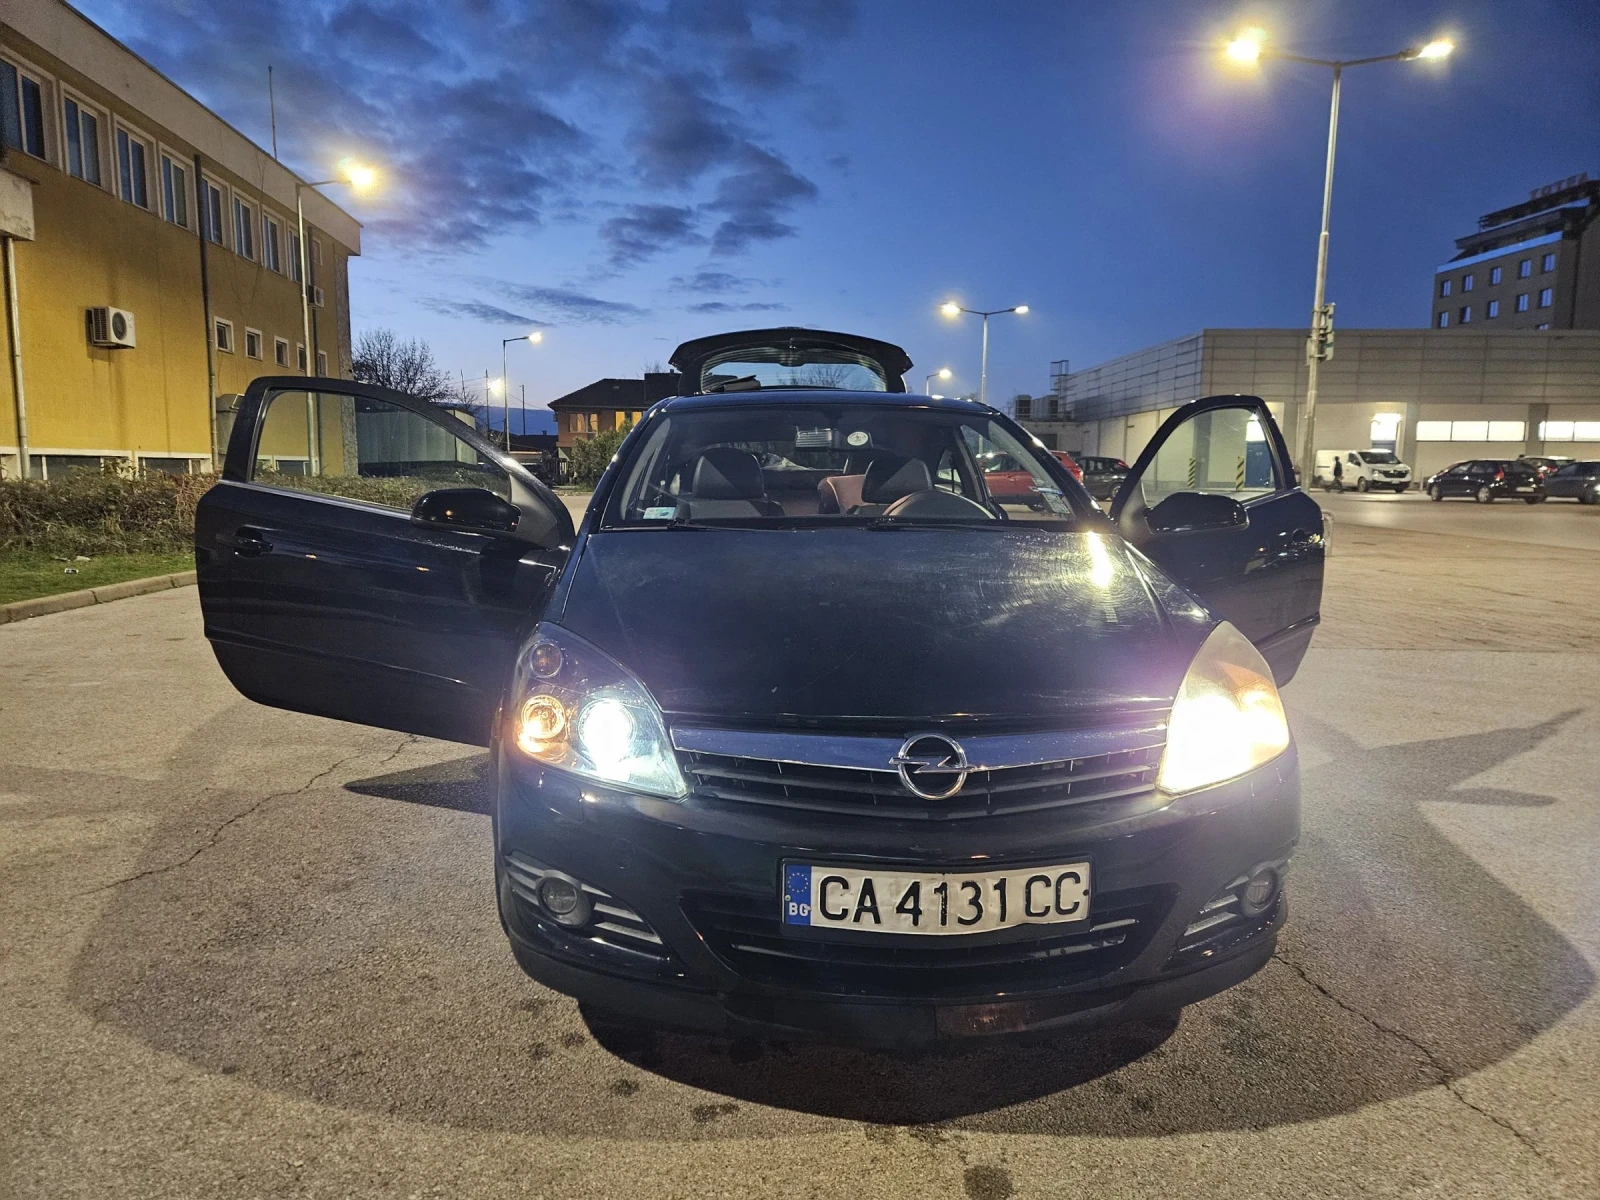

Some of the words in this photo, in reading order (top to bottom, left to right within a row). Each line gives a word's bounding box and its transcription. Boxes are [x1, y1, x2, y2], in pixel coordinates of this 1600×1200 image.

[789, 902, 809, 917] BG
[819, 875, 881, 924] CA
[895, 877, 1007, 927] 4131
[1025, 871, 1081, 918] CC
